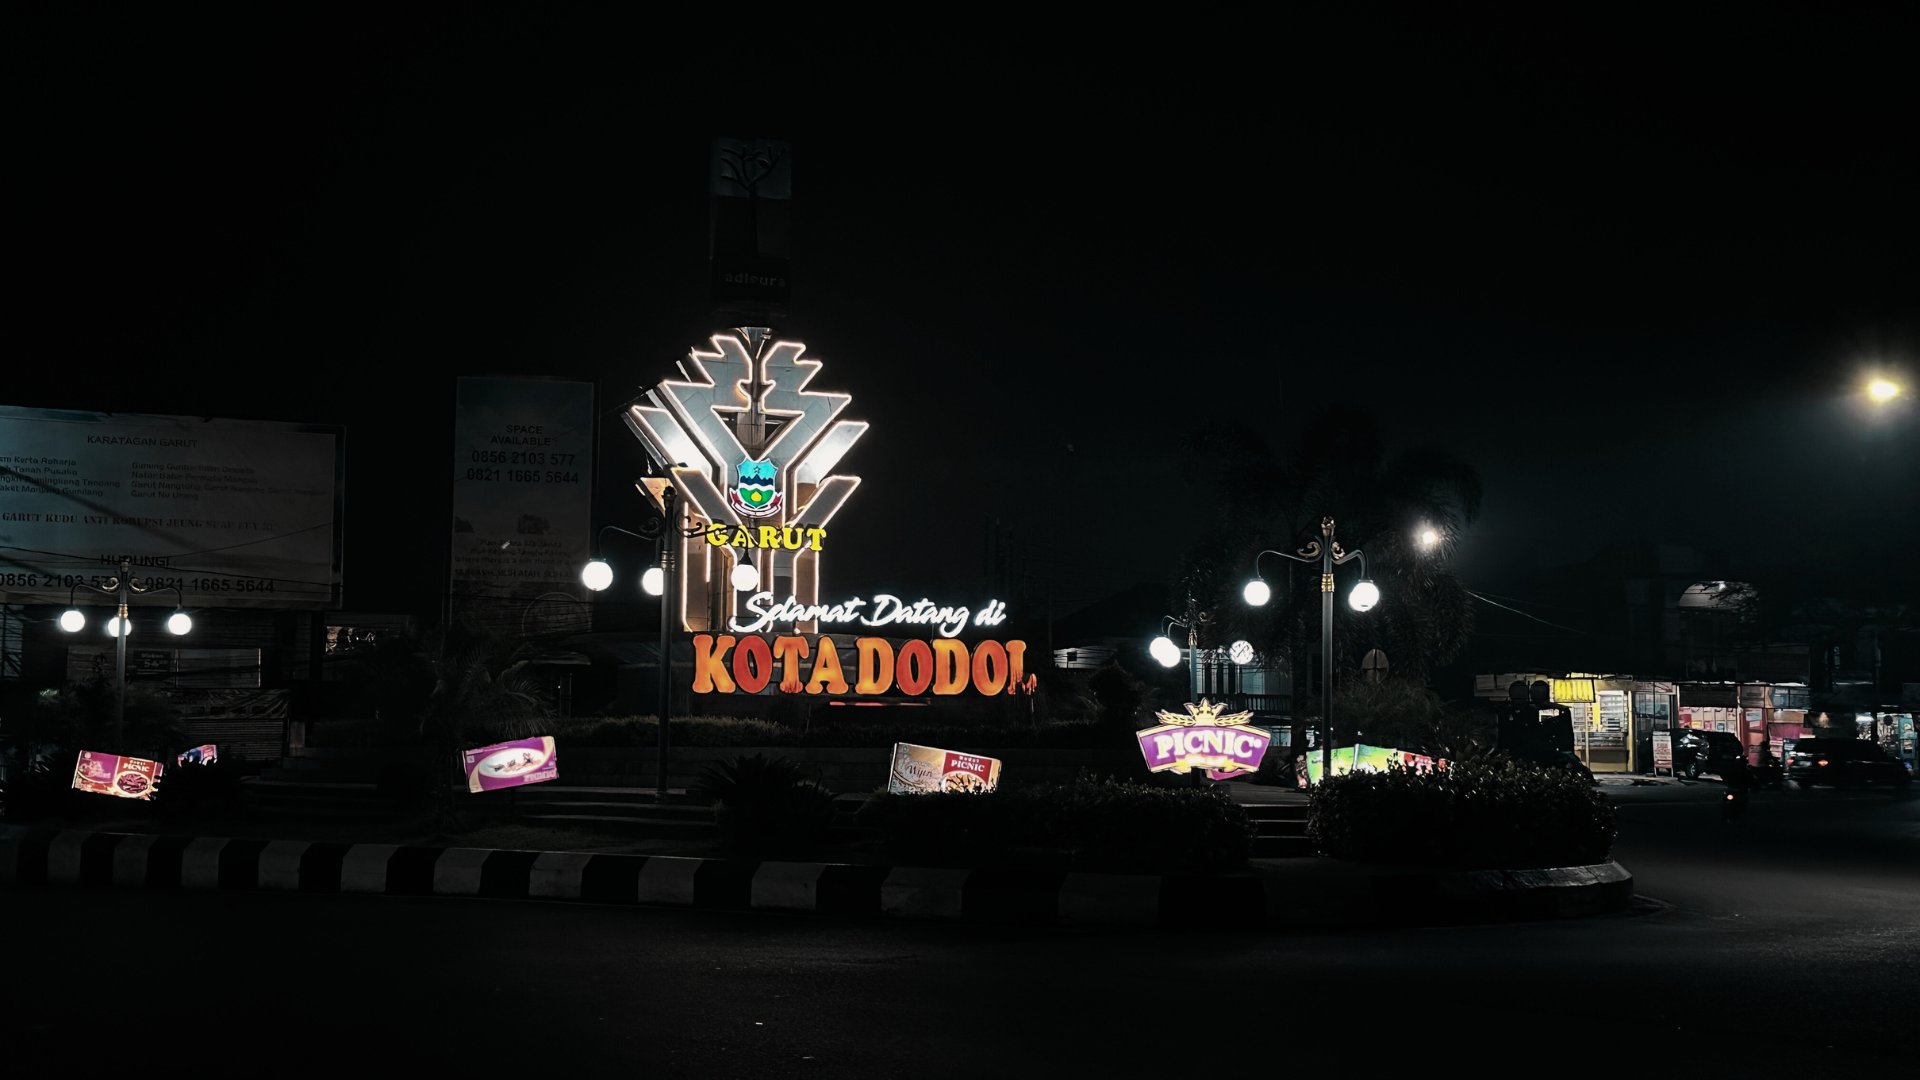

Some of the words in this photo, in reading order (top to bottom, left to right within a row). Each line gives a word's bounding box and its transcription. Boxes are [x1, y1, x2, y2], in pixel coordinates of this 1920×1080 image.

[506, 425, 543, 434] SPACE
[87, 435, 156, 446] KARATAGAN
[159, 438, 198, 447] GARUT
[490, 435, 551, 446] AVAILABLE
[14, 456, 38, 464] Kerta
[40, 457, 76, 467] Raharja
[471, 450, 506, 463] 0856
[511, 452, 545, 464] 2103
[550, 453, 576, 466] 577
[13, 466, 41, 474] Tanah
[131, 462, 164, 471] Gunung
[466, 468, 500, 481] 0821
[506, 470, 540, 482] 1665
[545, 472, 579, 484] 5644
[2, 512, 41, 522] GARUT
[45, 514, 78, 523] KUDU
[82, 515, 108, 524] ANTI
[112, 515, 163, 527] KORUPSI
[166, 518, 203, 528] JEUNG
[706, 523, 827, 551] GARUT
[43, 574, 85, 588] 2103
[145, 577, 184, 591] 0821
[191, 578, 231, 592] 1665
[236, 580, 275, 593] 5644
[729, 591, 867, 633] Selamat
[860, 594, 970, 638] Datang
[974, 598, 1007, 626] di
[692, 634, 849, 693] KOTA
[854, 636, 1037, 698] DODOL
[1154, 730, 1254, 760] PICNIC
[122, 763, 150, 772] PICNIC
[951, 759, 986, 773] PICNIC
